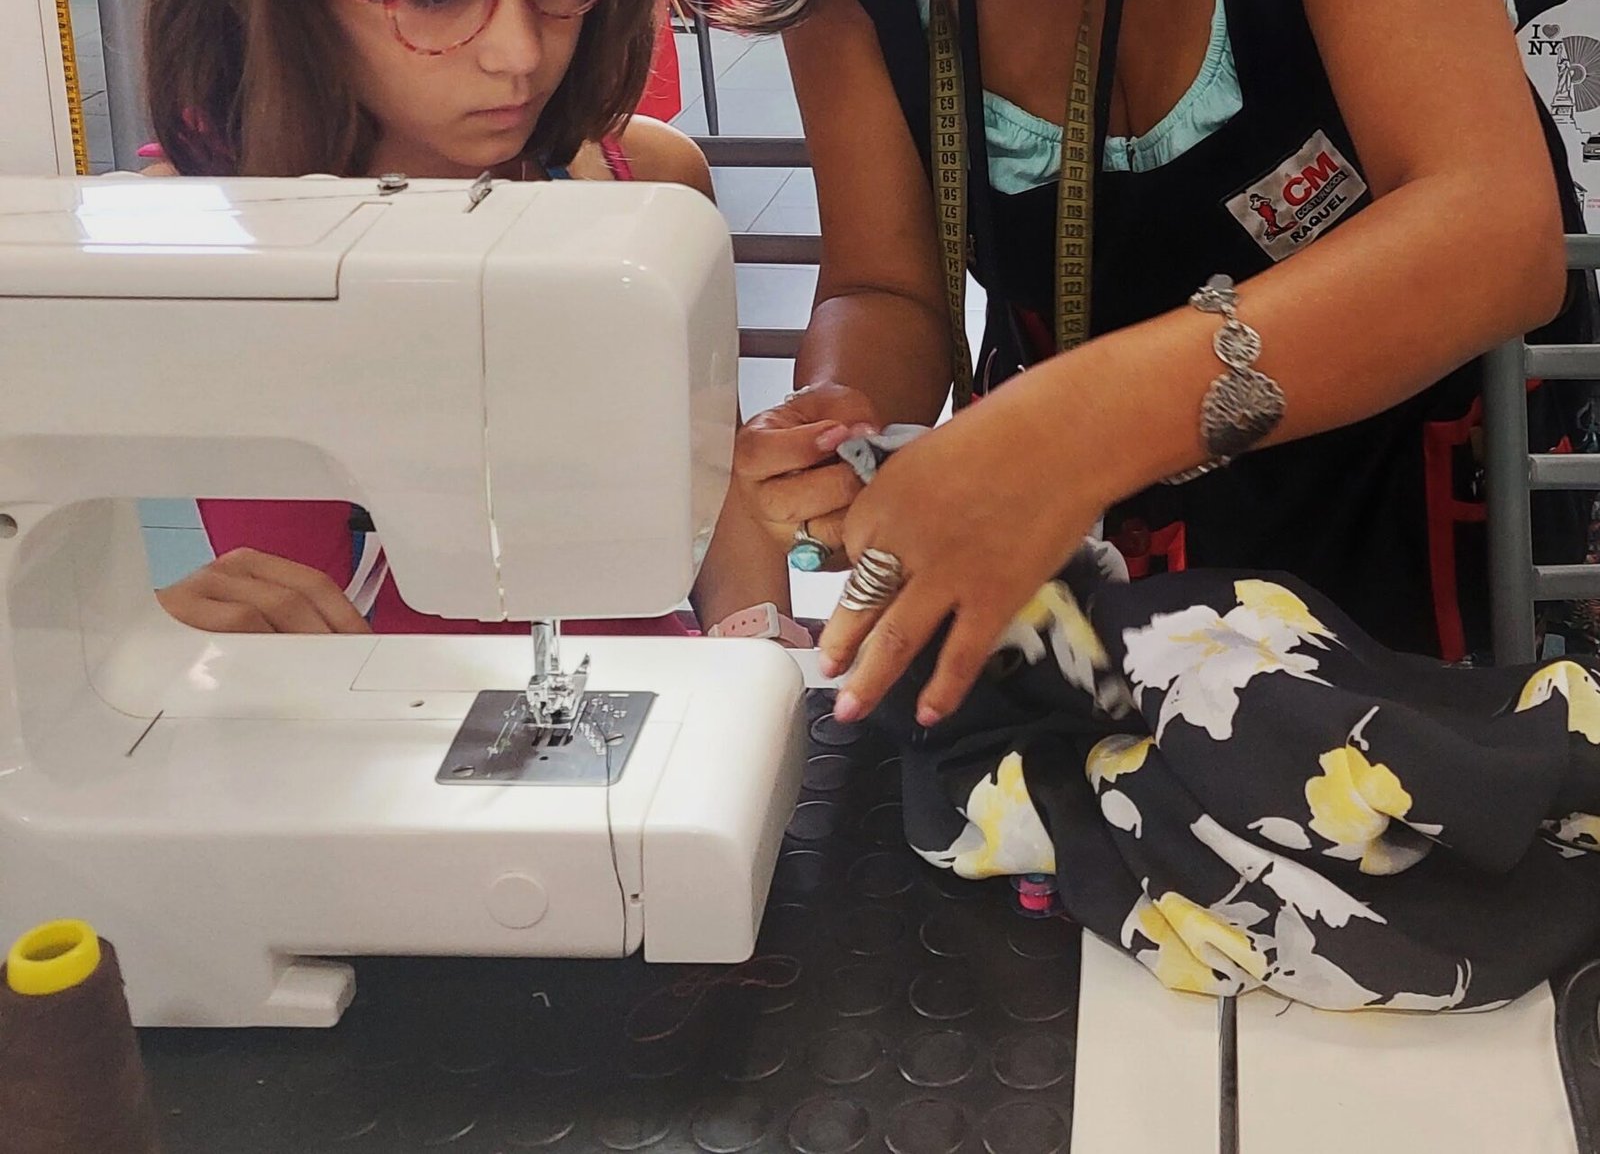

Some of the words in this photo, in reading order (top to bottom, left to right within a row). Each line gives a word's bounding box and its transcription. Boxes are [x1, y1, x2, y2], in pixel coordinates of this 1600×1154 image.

[1531, 24, 1541, 40] I
[1528, 40, 1563, 56] NY
[939, 60, 953, 74] 65
[940, 78, 954, 92] 64
[940, 97, 955, 111] 63
[941, 116, 956, 129] 62
[942, 134, 955, 147] 61
[1071, 127, 1085, 141] 115
[942, 152, 957, 165] 60
[1070, 146, 1085, 160] 116
[943, 170, 957, 183] 59
[1069, 166, 1084, 179] 117
[1282, 150, 1340, 207] CM
[944, 188, 957, 201] 58
[1067, 186, 1083, 199] 118
[945, 207, 957, 219] 57
[1066, 205, 1083, 217] 119
[1290, 193, 1347, 244] RAQUEL
[946, 224, 958, 237] 56
[946, 242, 959, 255] 55
[1066, 243, 1083, 256] 121
[1064, 262, 1083, 275] 122
